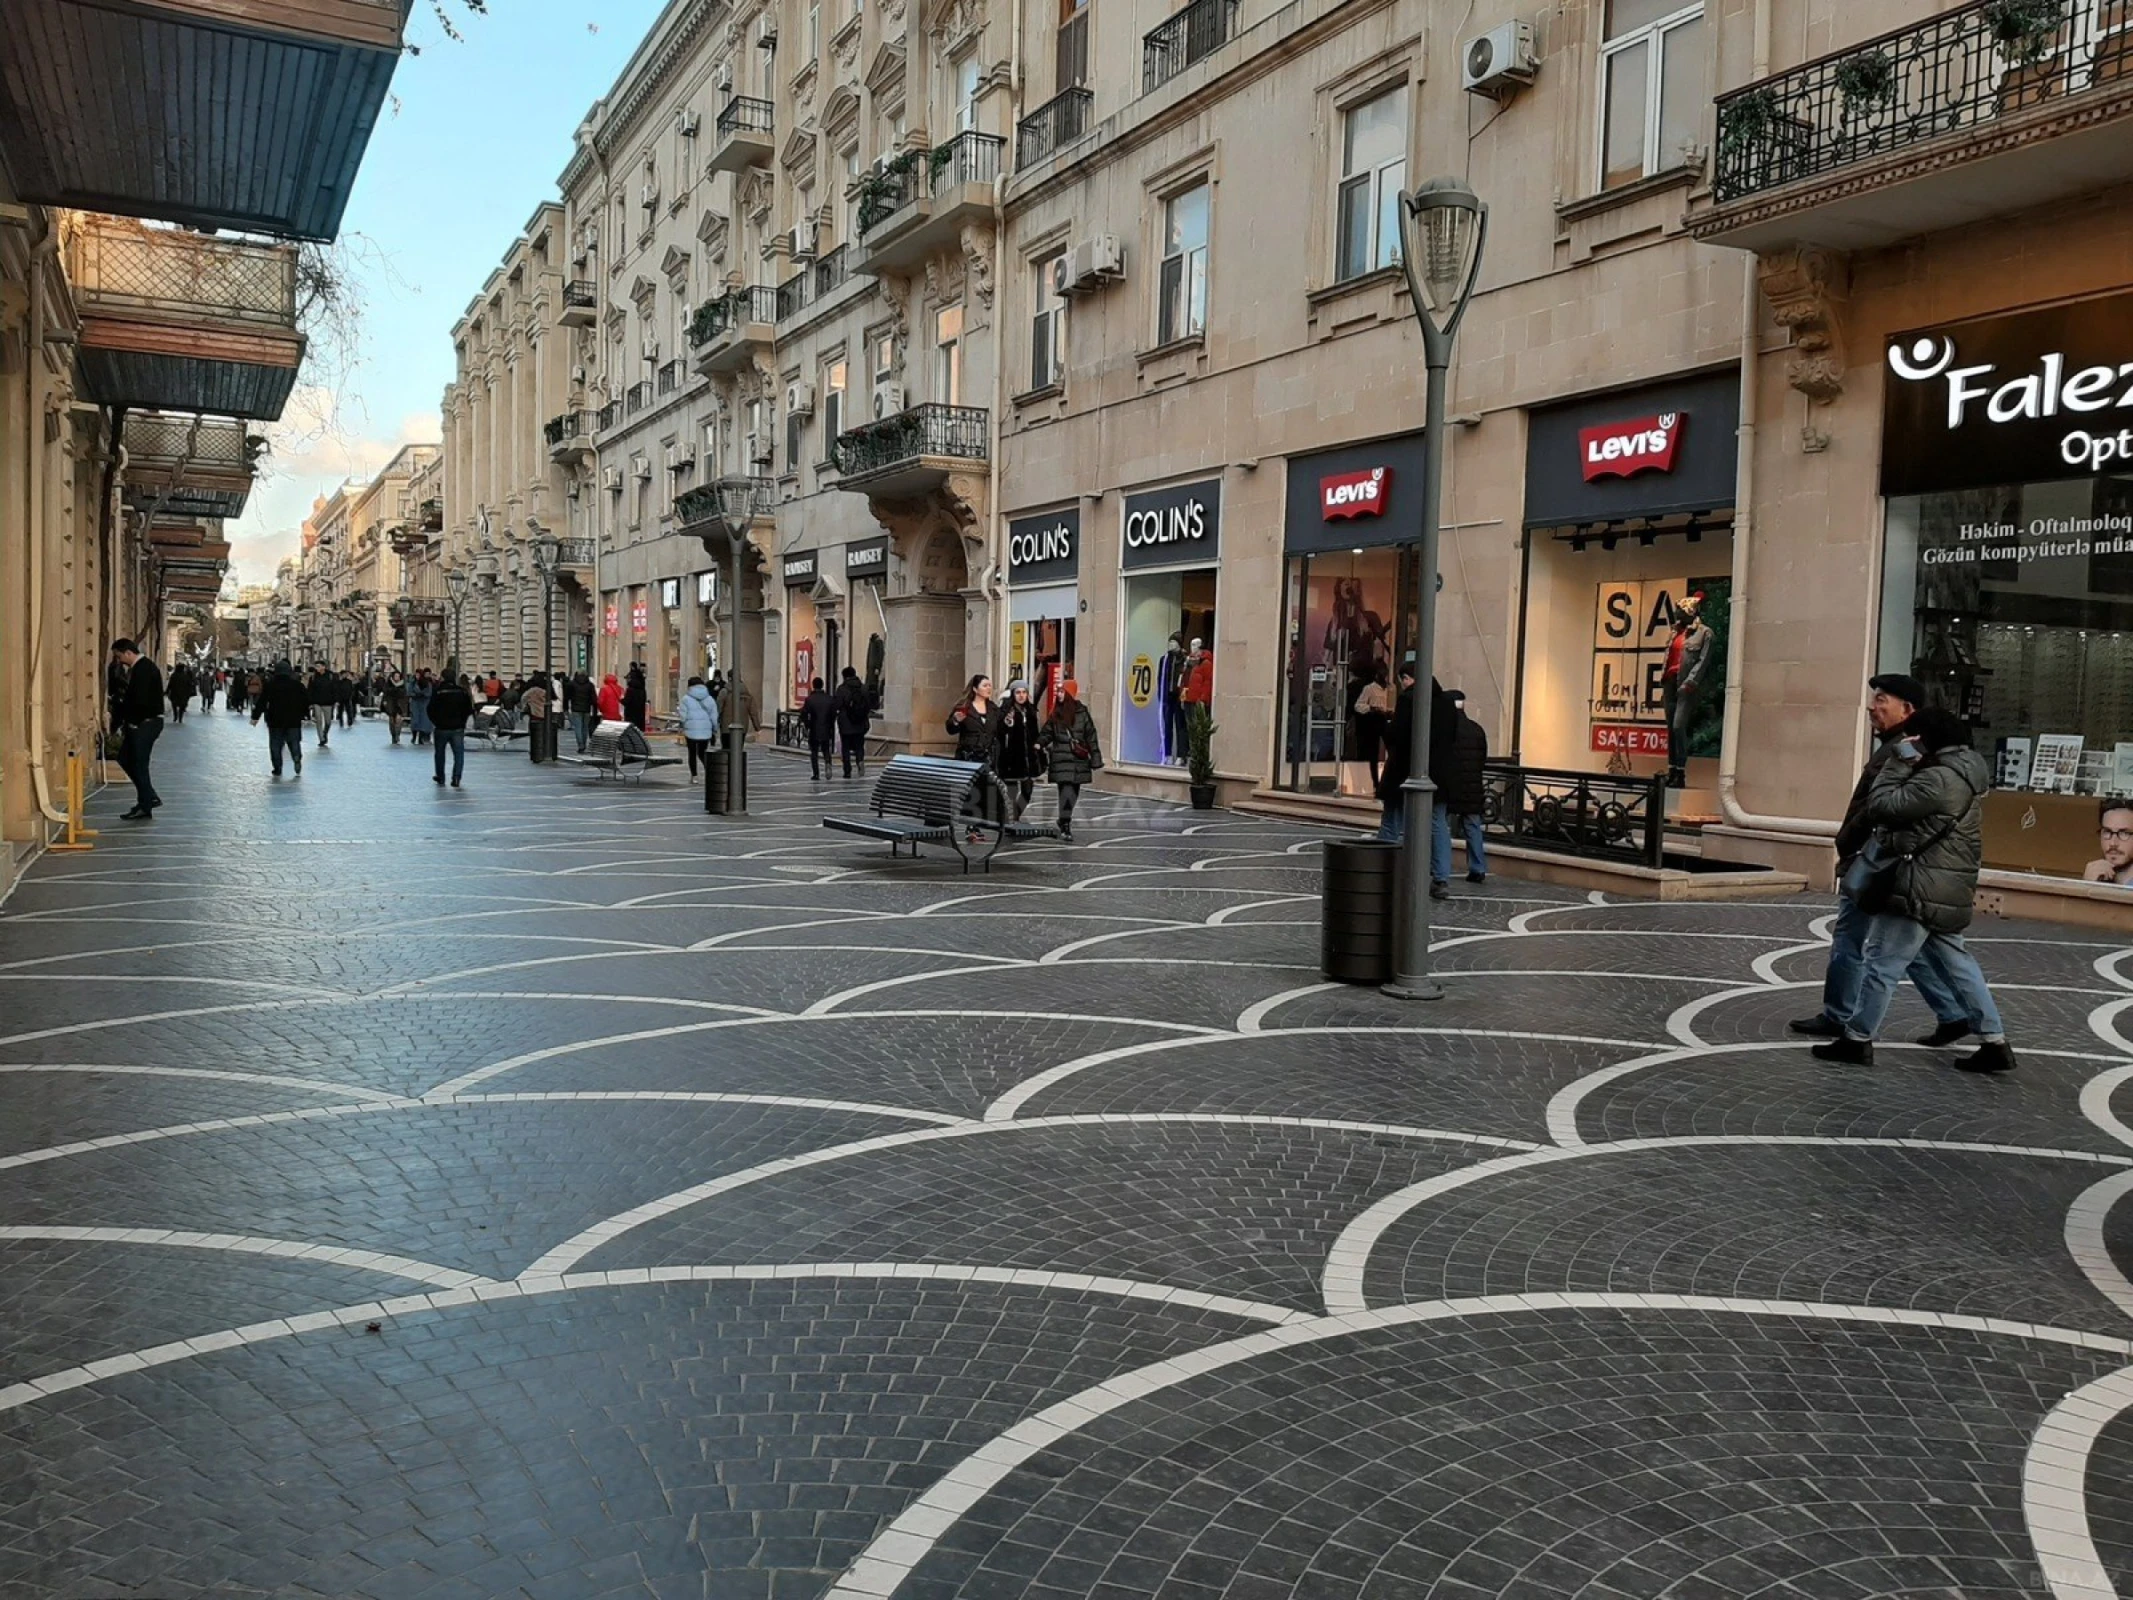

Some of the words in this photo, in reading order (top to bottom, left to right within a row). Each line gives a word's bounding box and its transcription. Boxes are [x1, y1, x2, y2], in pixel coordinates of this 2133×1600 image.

[1588, 430, 1668, 462] Levi's
[1326, 480, 1379, 505] Levi's
[1127, 498, 1205, 547] COLIN'S
[1960, 521, 2014, 540] Həkim
[2029, 513, 2133, 536] Oftalmoloq
[1010, 522, 1070, 566] COLIN'S
[1923, 547, 1975, 564] Gözün
[1980, 538, 2090, 563] kompyüterlə
[1132, 664, 1152, 696] 70
[1597, 730, 1638, 748] SALE
